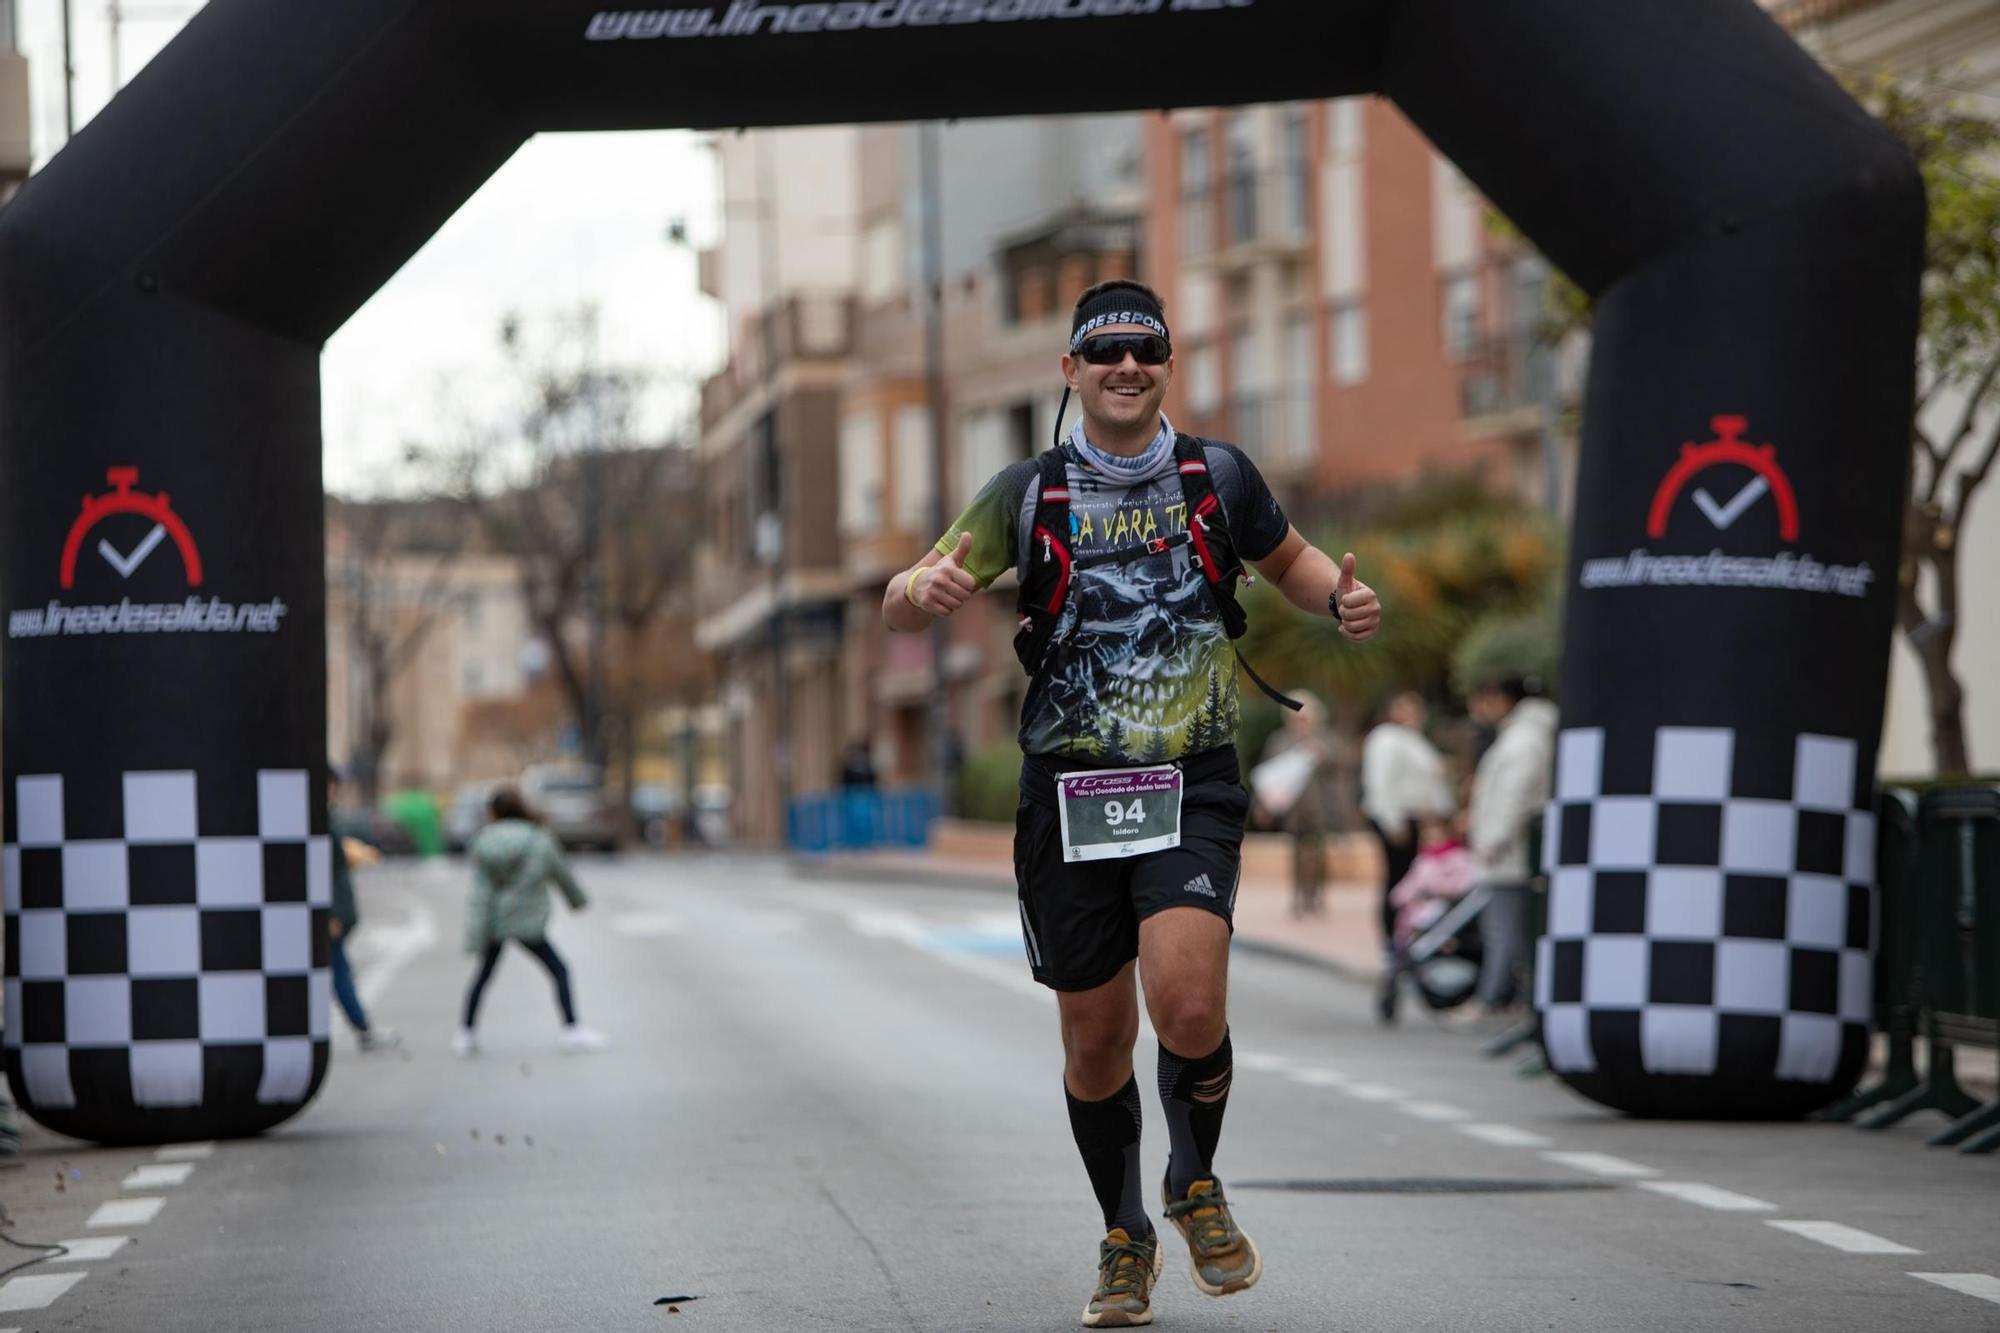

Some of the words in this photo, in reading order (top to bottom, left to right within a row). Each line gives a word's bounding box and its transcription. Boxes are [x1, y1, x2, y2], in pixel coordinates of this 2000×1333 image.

[585, 0, 1252, 41] www.lineadesalida.
[1071, 312, 1166, 348] OMPRESSPORT
[1078, 511, 1094, 546] A
[1103, 508, 1158, 545] VARA
[1165, 501, 1188, 535] TR
[1580, 547, 1874, 597] www.lineadesalida.net
[9, 595, 288, 638] www.lineadesalida.net
[1082, 776, 1134, 787] Cross
[1090, 789, 1094, 797] y
[1095, 787, 1125, 795] Condado
[1135, 784, 1154, 792] Santa
[1104, 798, 1146, 826] 94
[1113, 828, 1139, 836] Isidoro
[1183, 882, 1217, 898] adidas
